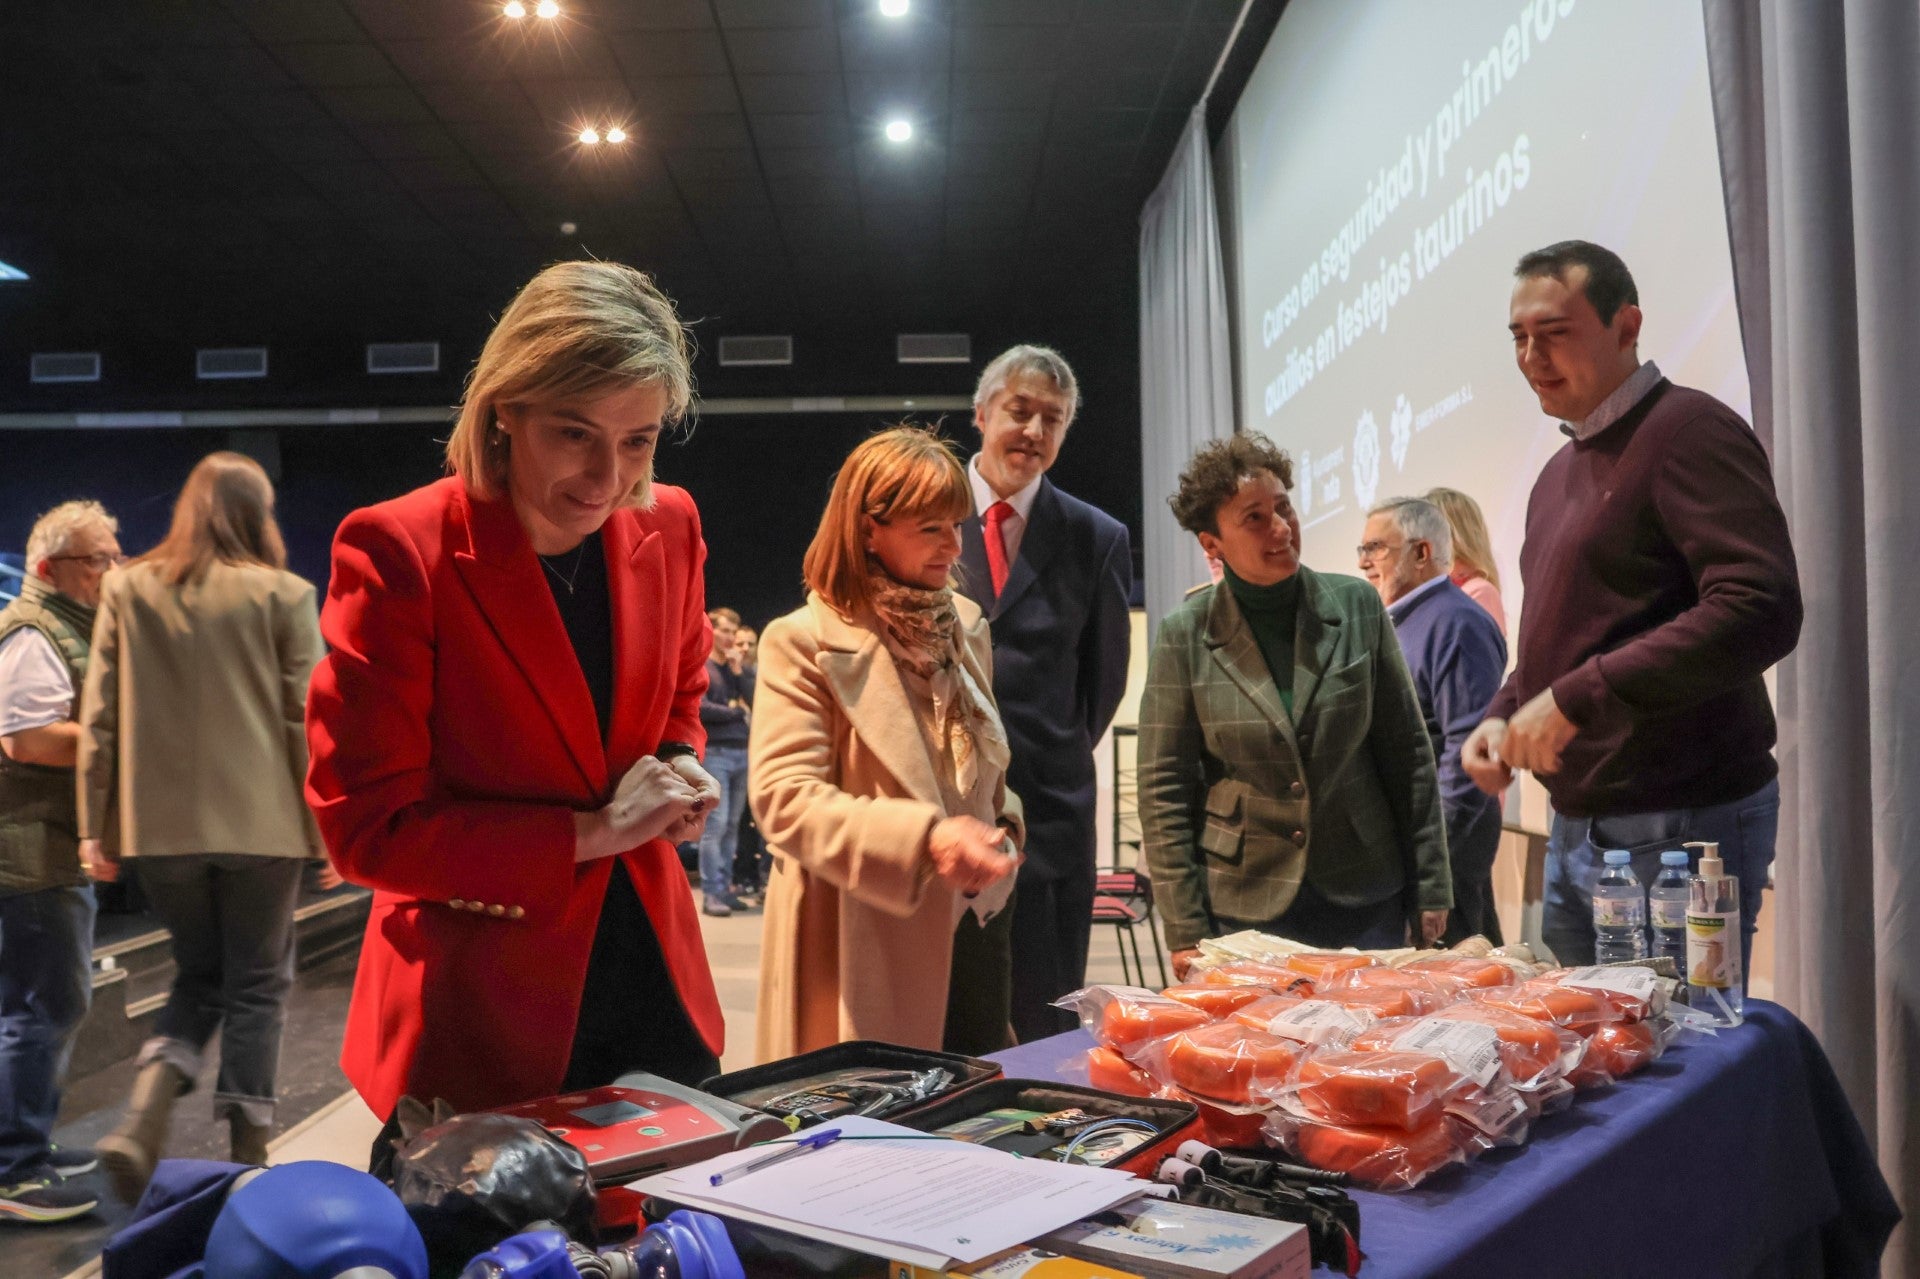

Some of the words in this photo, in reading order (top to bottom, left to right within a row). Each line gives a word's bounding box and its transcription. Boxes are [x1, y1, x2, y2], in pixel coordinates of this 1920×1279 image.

[1263, 284, 1299, 349] Curso
[1301, 260, 1319, 308] en
[1321, 134, 1413, 287] seguridad
[1416, 123, 1431, 199] y
[1265, 346, 1314, 418] auxilios
[1316, 324, 1336, 373] en
[1337, 249, 1411, 353] festejos
[1414, 132, 1531, 280] taurinos
